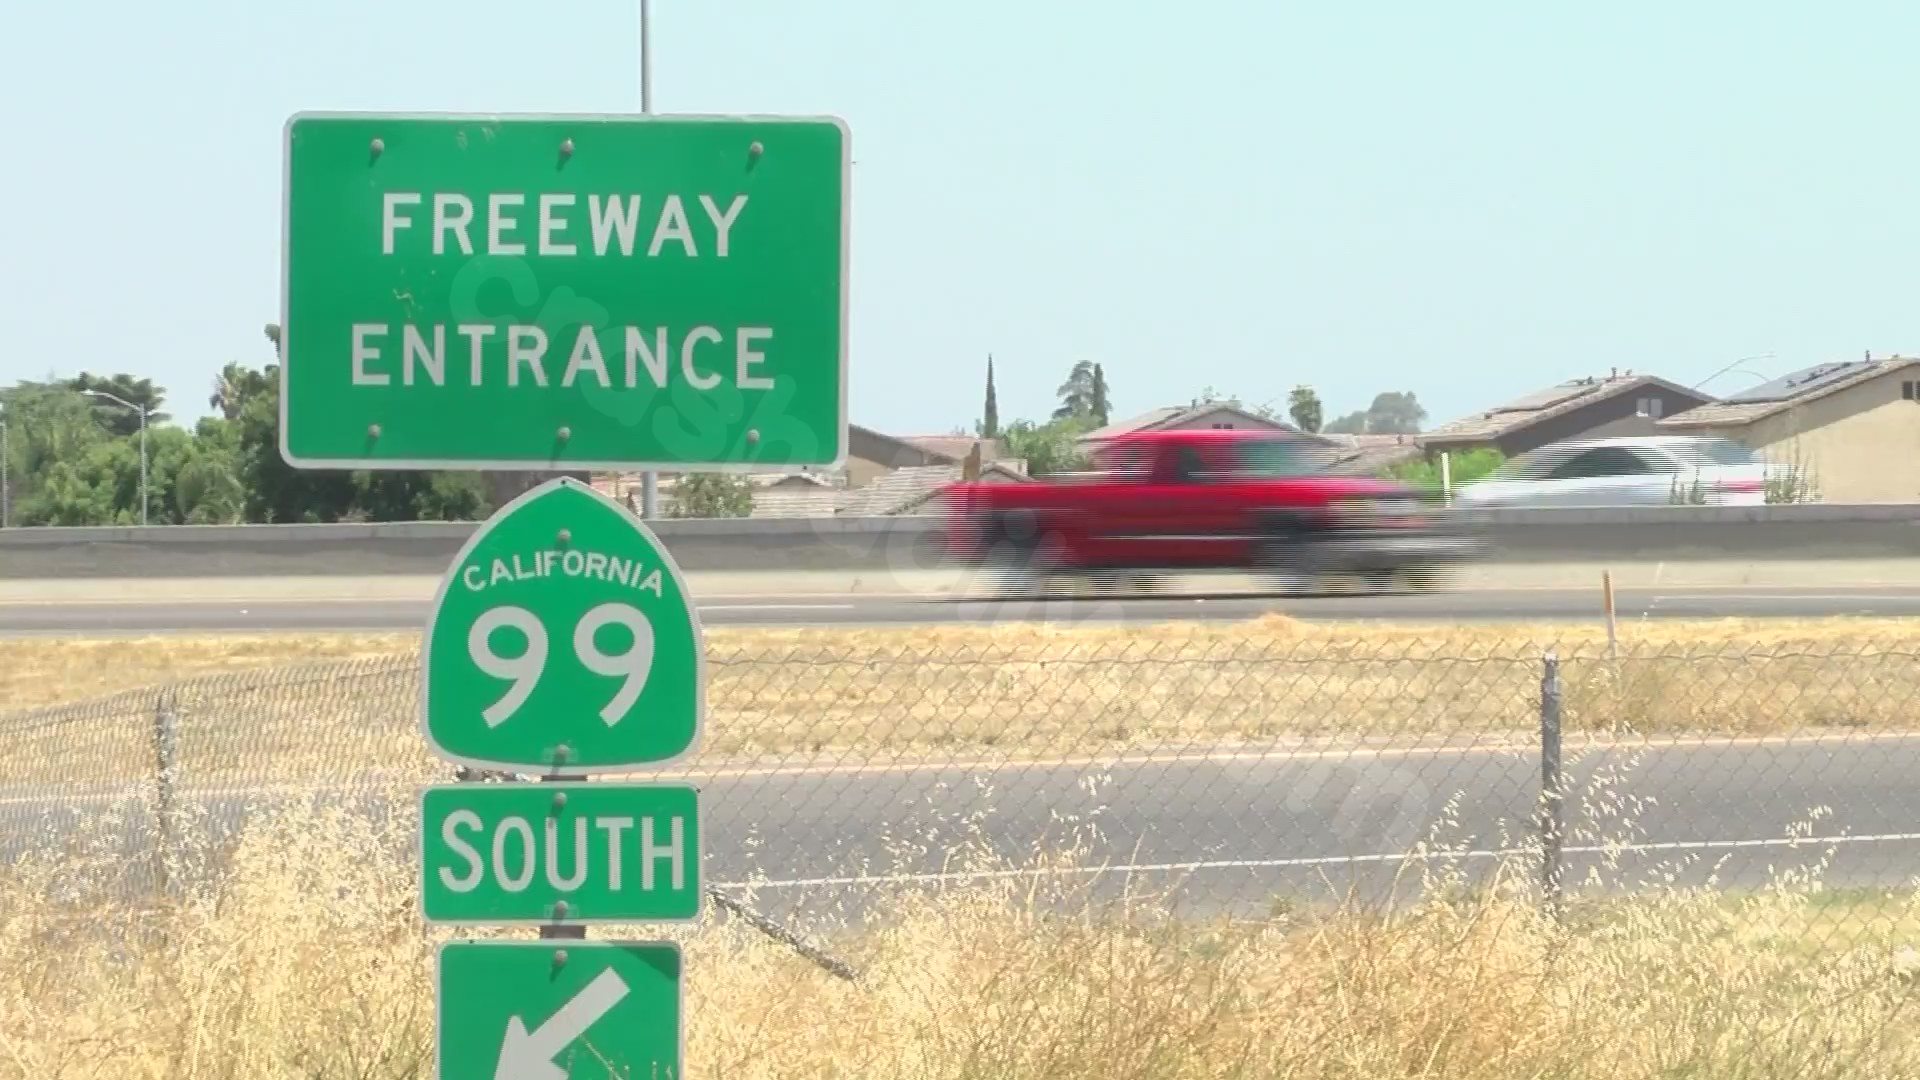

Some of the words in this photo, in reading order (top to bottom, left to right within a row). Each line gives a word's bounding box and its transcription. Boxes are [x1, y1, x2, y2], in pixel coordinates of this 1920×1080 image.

[382, 192, 748, 257] FREEWAY
[351, 323, 775, 390] ENTRANCE
[463, 549, 664, 599] CALIFORNIA
[467, 602, 656, 728] 99
[438, 809, 685, 893] SOUTH
